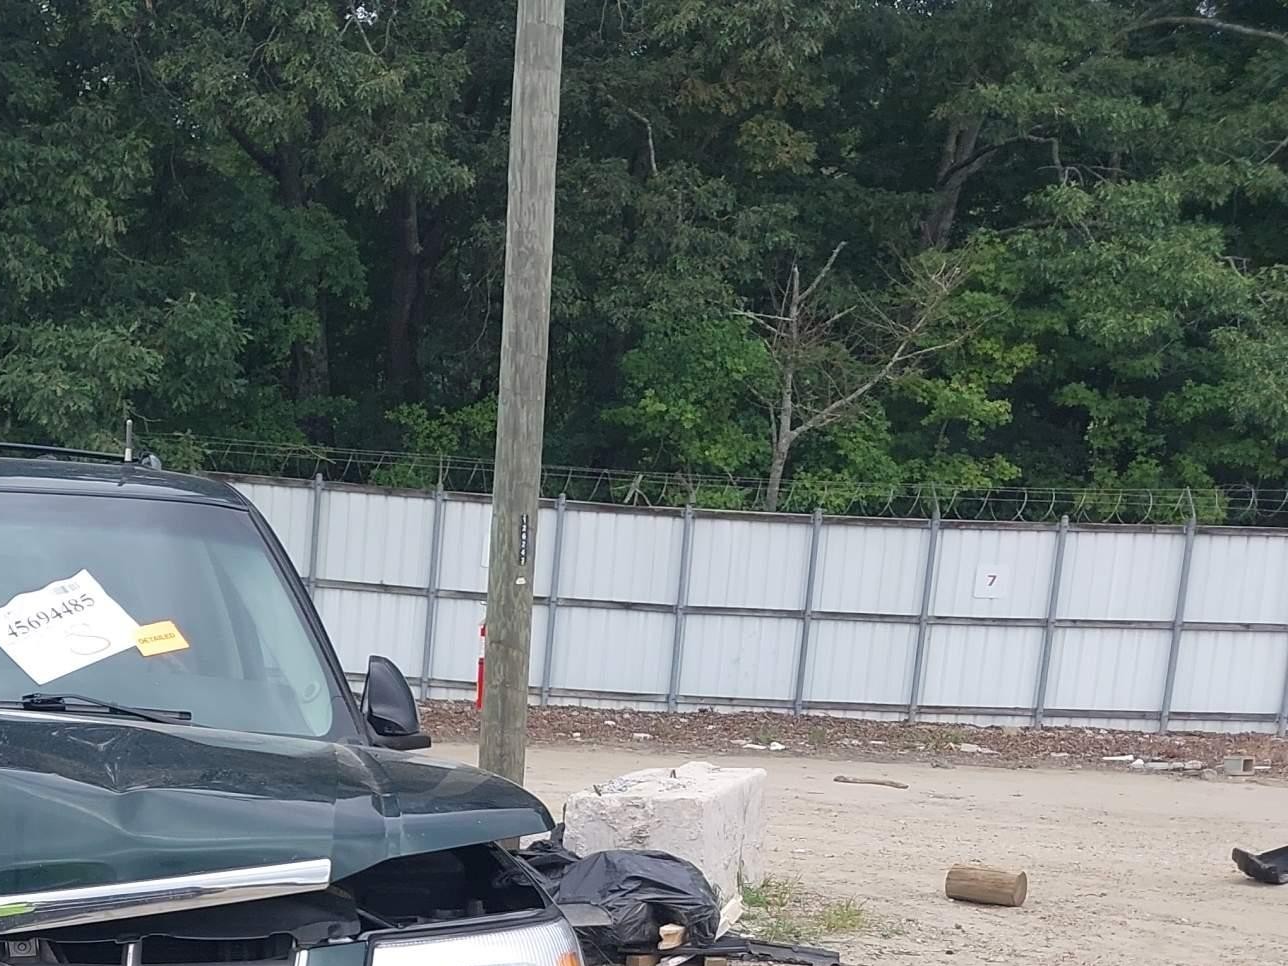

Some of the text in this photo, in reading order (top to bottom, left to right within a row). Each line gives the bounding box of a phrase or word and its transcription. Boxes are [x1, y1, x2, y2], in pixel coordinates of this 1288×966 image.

[987, 575, 997, 586] 7
[7, 593, 96, 638] 45694485
[138, 632, 175, 645] DETAILED
